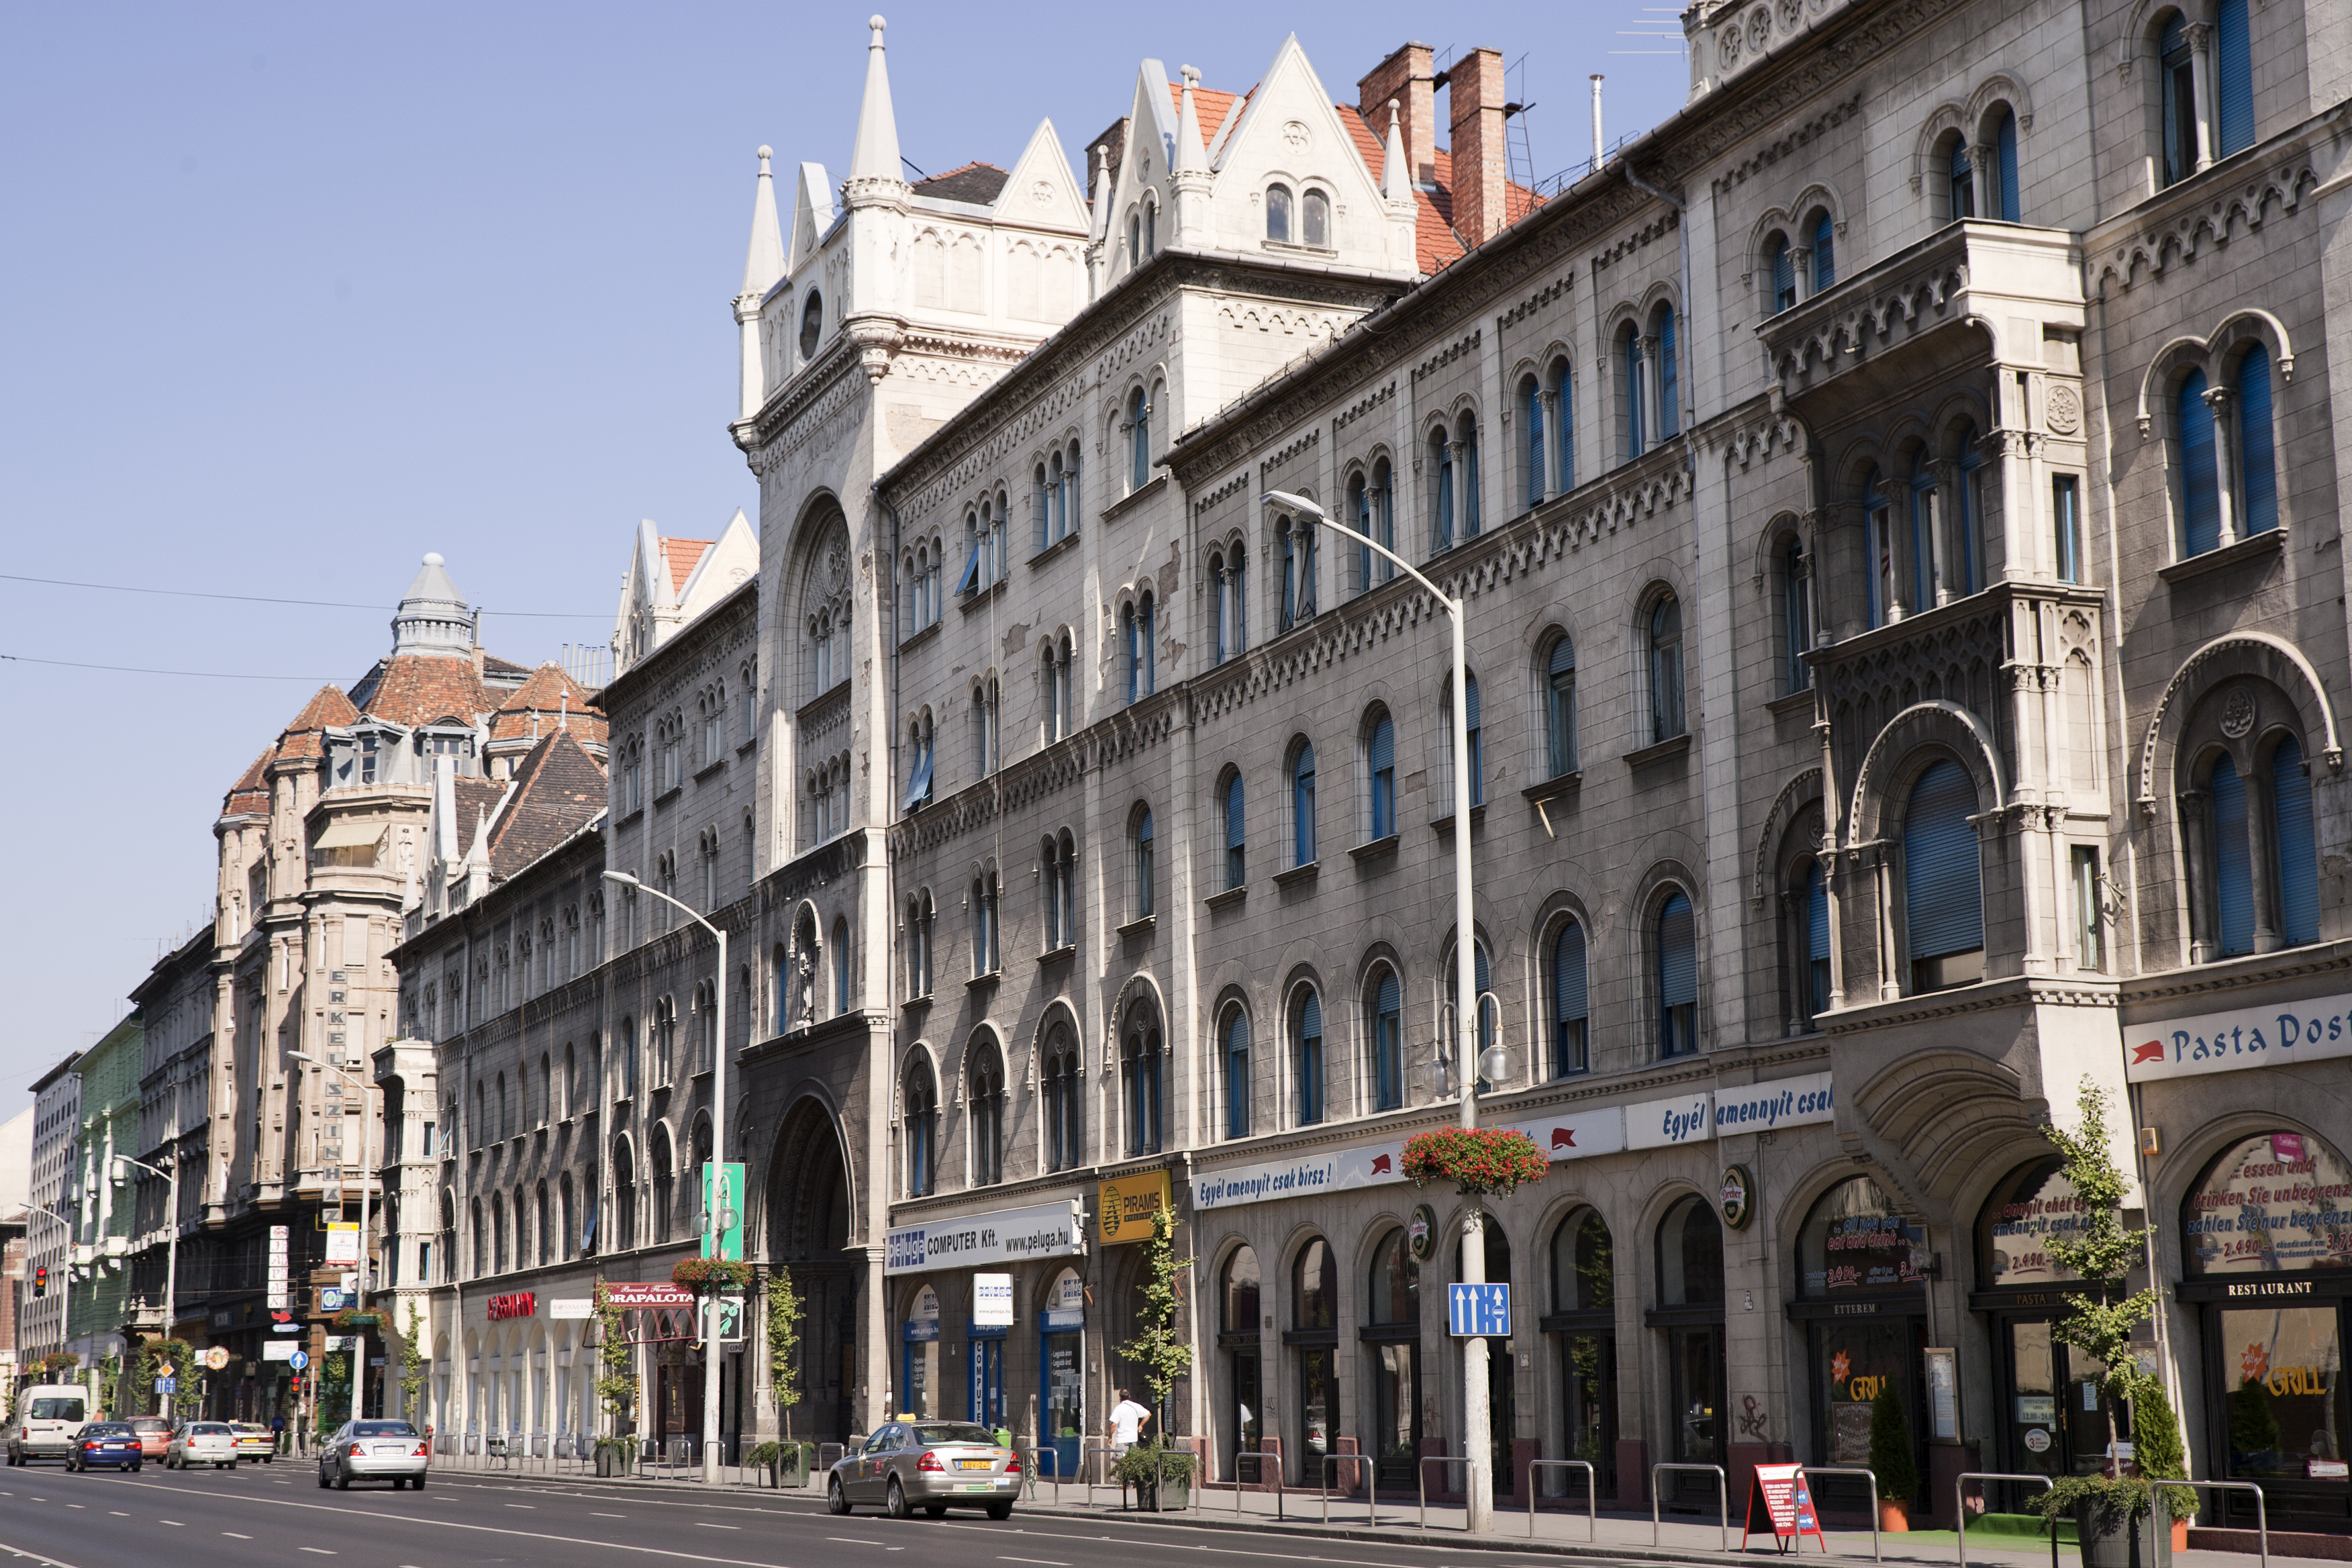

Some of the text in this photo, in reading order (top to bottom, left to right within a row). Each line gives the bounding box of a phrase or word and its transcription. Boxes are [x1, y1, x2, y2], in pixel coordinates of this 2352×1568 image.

[330, 971, 346, 1065] ERKEL
[2171, 1026, 2267, 1064] Pasta
[1663, 1102, 1706, 1141] Egyél
[1716, 1089, 1793, 1126] amennyit
[2243, 1163, 2281, 1178] essen
[2287, 1155, 2314, 1174] und
[1201, 1178, 1225, 1207] Egyél
[1227, 1172, 1270, 1199] amennyit
[1273, 1168, 1295, 1191] csak
[1298, 1164, 1324, 1187] bírsz
[1722, 1189, 1741, 1201] Dreher
[2194, 1183, 2352, 1208] trinken Sie unbegrenz
[1124, 1192, 1160, 1214] PIRAMIS
[2004, 1198, 2043, 1220] annyit
[1844, 1216, 1859, 1232] all
[1859, 1218, 1879, 1236] you
[1881, 1216, 1900, 1230] can
[1992, 1216, 2047, 1238] amennyit
[2051, 1214, 2077, 1232] csak
[2188, 1215, 2231, 1234] zahlen
[2237, 1213, 2258, 1231] Sie
[2261, 1214, 2285, 1229] nur
[889, 1227, 1068, 1263] peluga COMPUTER Kft. www.peluga.hu
[1828, 1234, 1846, 1251] eat
[1847, 1233, 1867, 1249] and
[1869, 1229, 1897, 1248] drink
[621, 1285, 648, 1293] Bernard
[979, 1287, 1011, 1297] peluga
[2017, 1294, 2046, 1304] PASTA
[2228, 1282, 2312, 1295] RESTAURANT
[1834, 1304, 1875, 1314] ÉTTEREM
[2268, 1365, 2327, 1397] GRILL
[2029, 1438, 2035, 1449] 3
